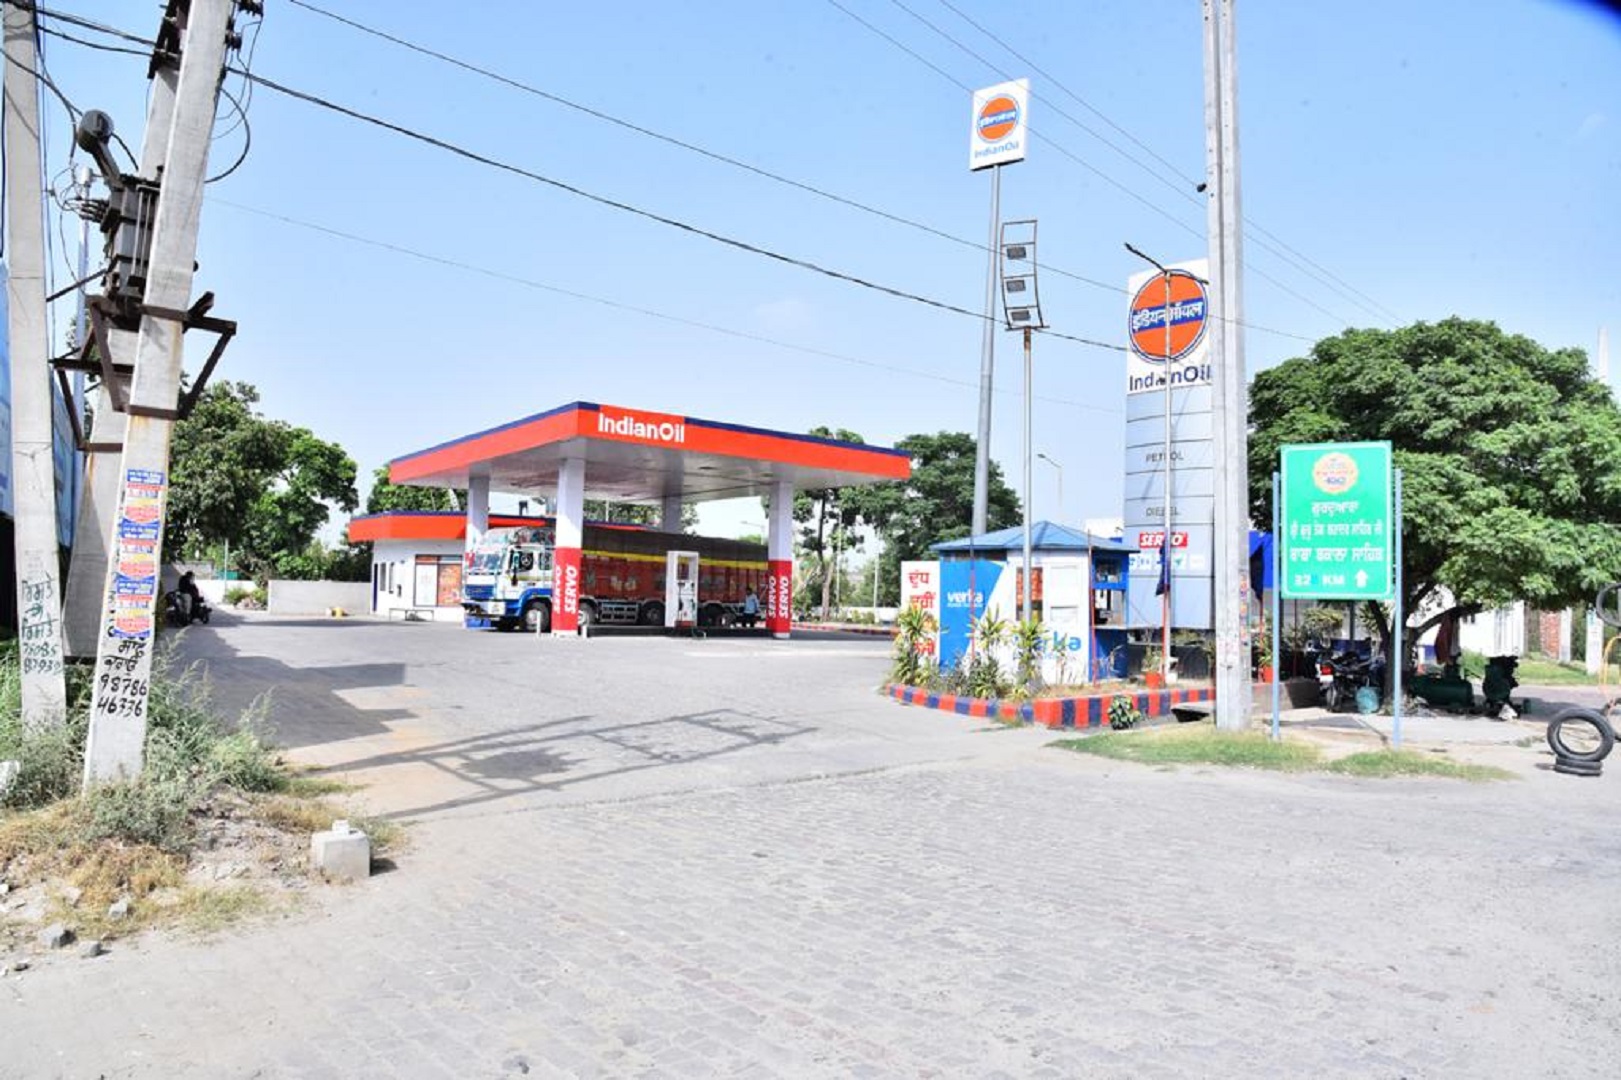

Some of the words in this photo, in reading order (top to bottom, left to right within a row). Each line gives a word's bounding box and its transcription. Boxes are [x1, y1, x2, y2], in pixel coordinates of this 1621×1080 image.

[1130, 364, 1211, 391] IndnOil
[597, 412, 685, 443] IndianOil
[1146, 450, 1184, 463] PETOL
[1140, 534, 1182, 546] SERO
[564, 563, 577, 614] SERVO
[768, 575, 776, 618] SERVO
[778, 575, 788, 618] SERVO
[101, 674, 147, 696] 98786
